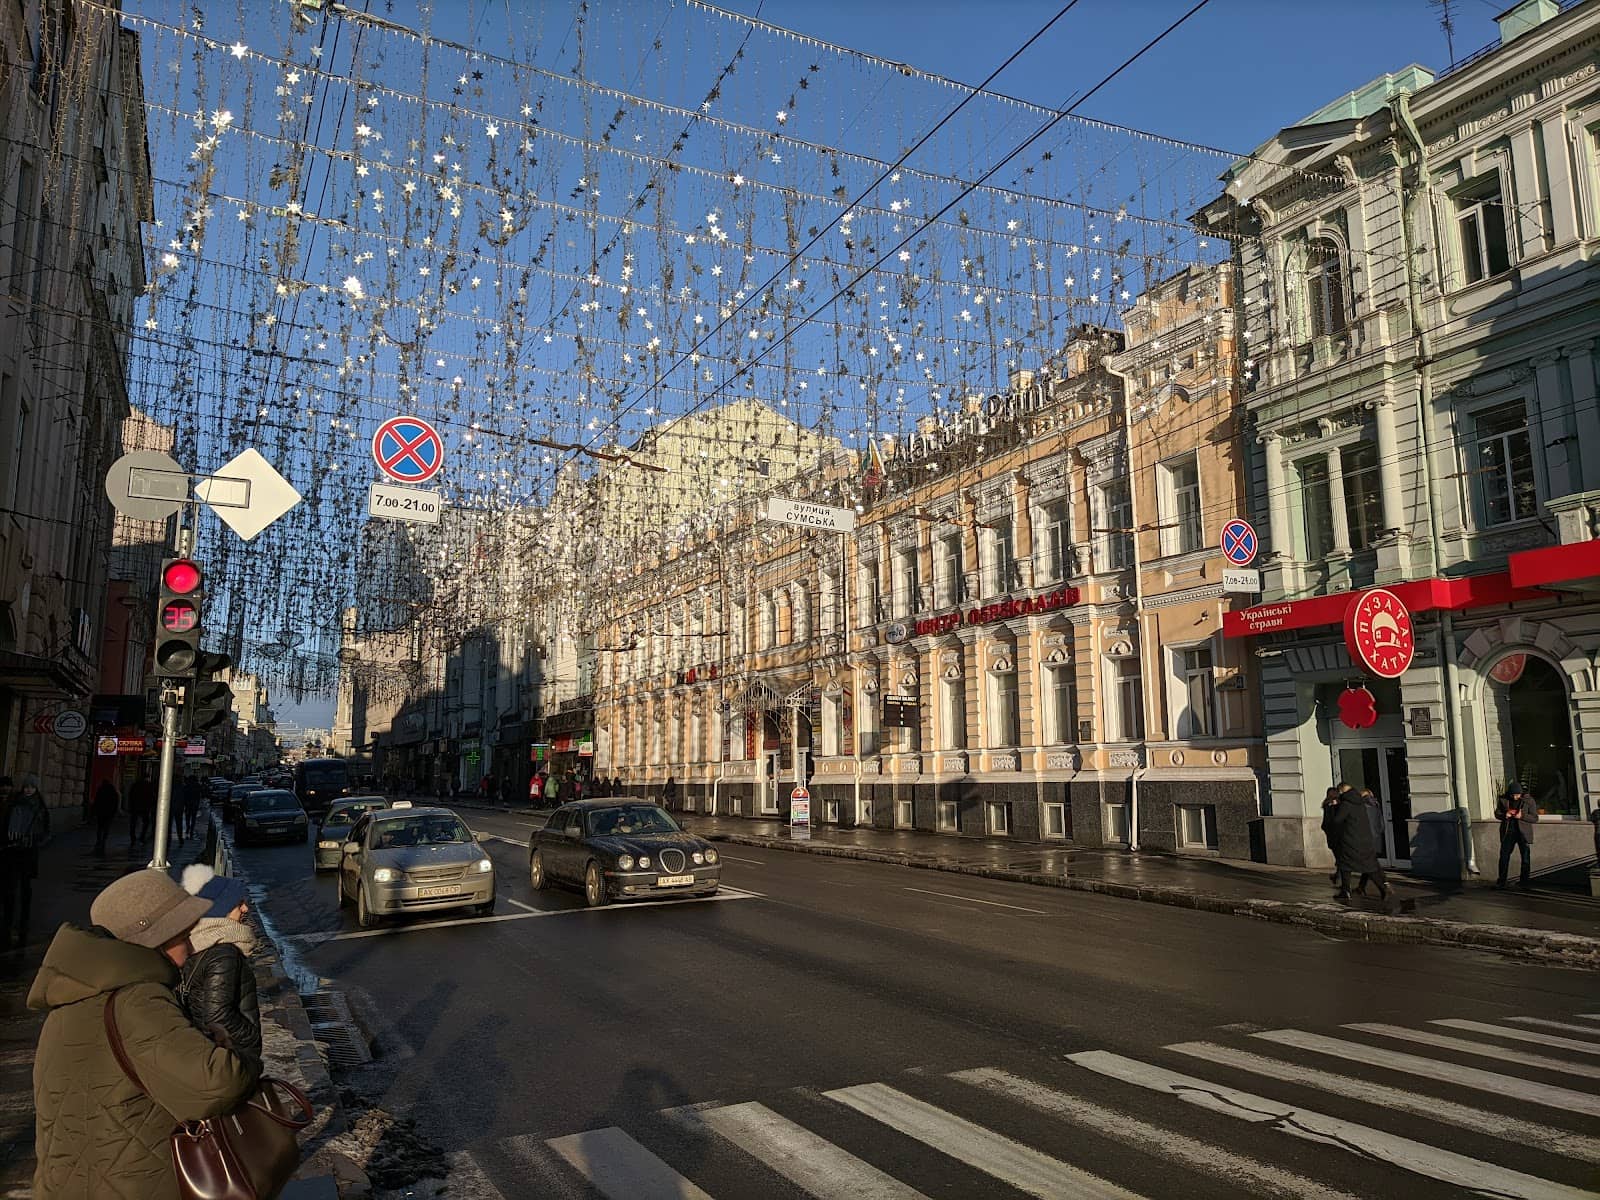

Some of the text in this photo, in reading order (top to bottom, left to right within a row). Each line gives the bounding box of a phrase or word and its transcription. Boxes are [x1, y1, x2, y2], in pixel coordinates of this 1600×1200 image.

[375, 494, 435, 513] 7.00-21.00
[786, 511, 835, 527] СУМСЬКА
[165, 607, 193, 629] 35
[1239, 603, 1292, 622] Українські
[1359, 596, 1409, 638] ПУЗАТА
[1249, 617, 1283, 632] страви
[1369, 648, 1407, 670] ХАТА
